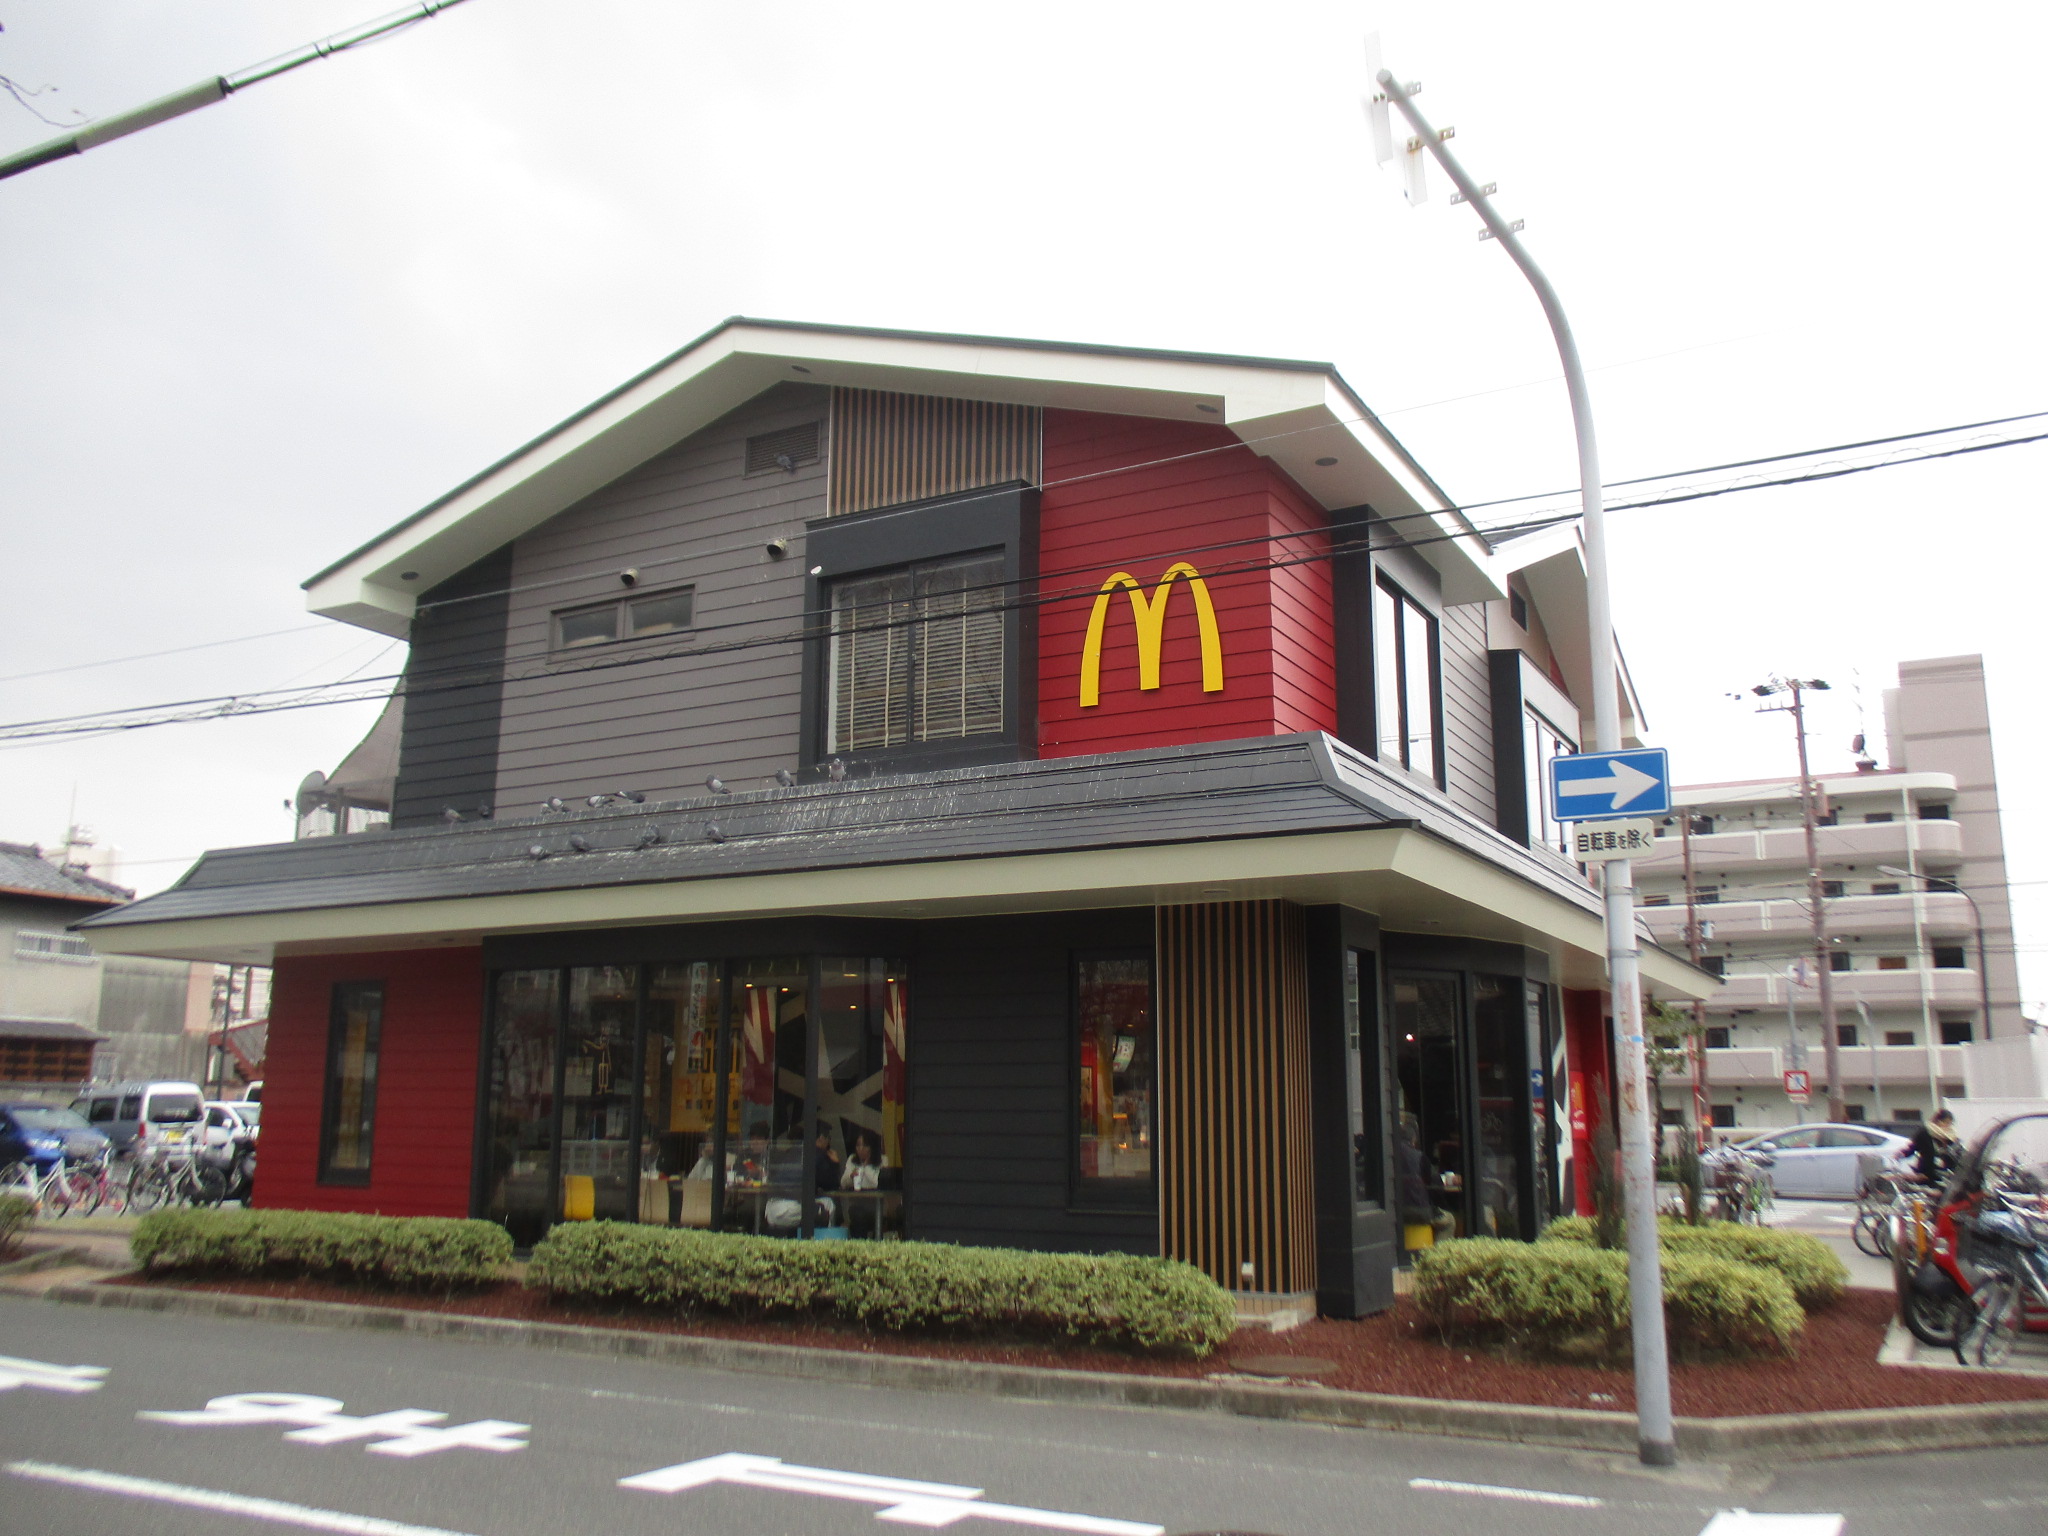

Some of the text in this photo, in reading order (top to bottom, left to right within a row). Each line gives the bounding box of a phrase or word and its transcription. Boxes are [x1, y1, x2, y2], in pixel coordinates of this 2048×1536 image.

[1578, 829, 1651, 852] 自転車を除く
